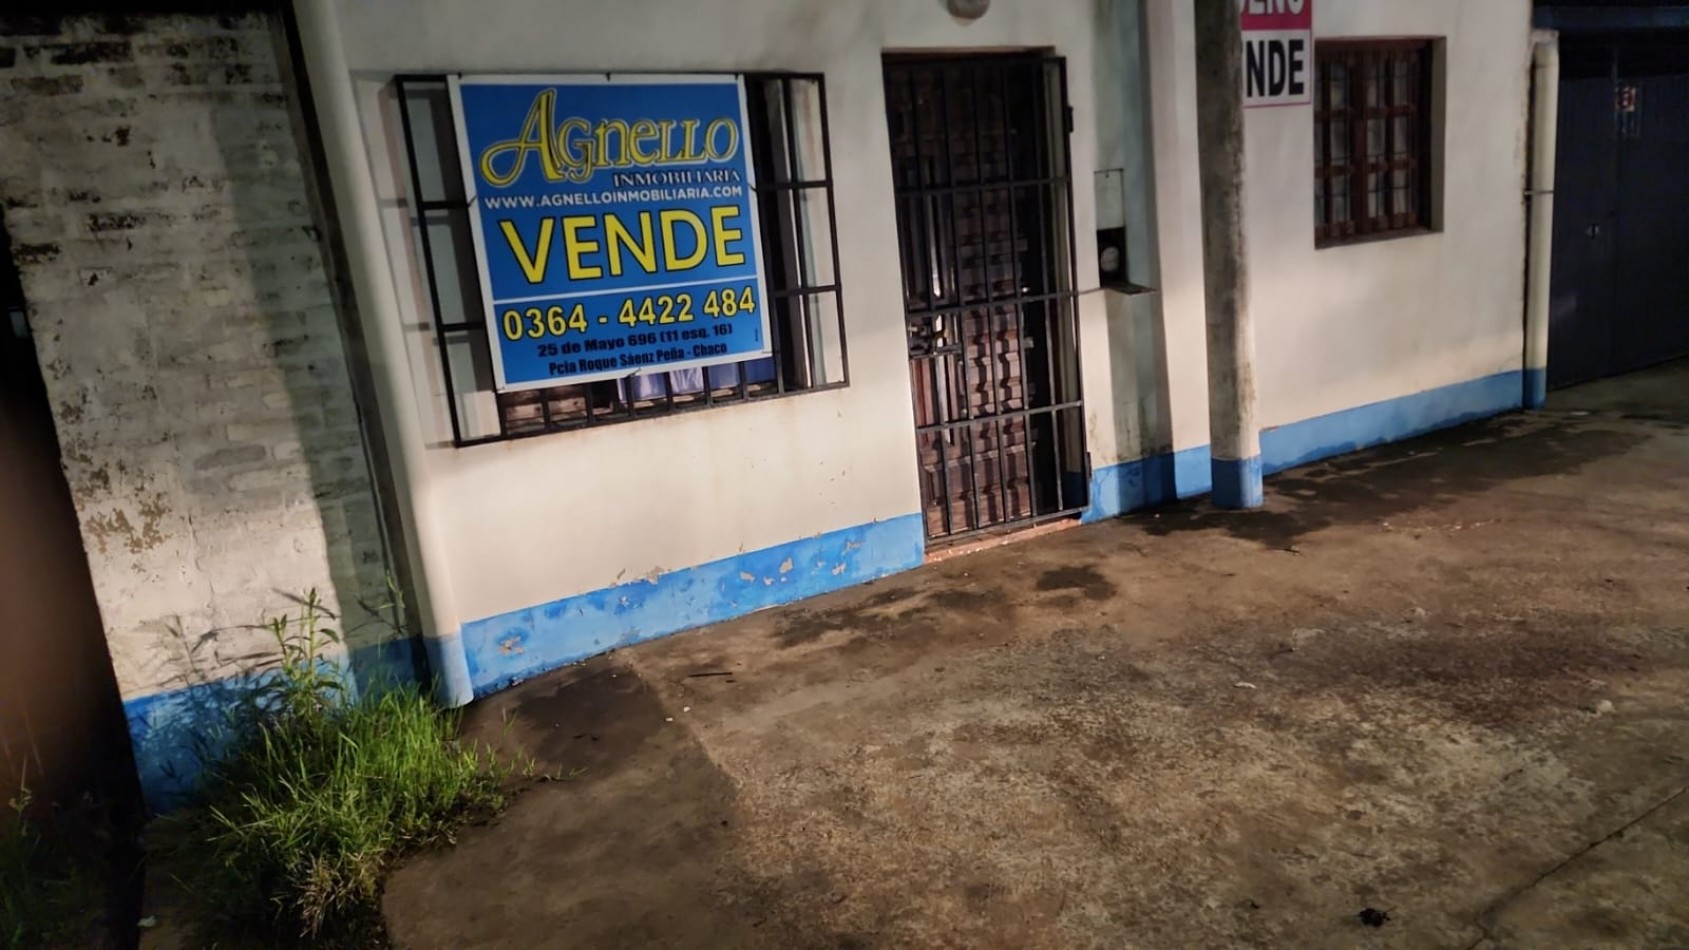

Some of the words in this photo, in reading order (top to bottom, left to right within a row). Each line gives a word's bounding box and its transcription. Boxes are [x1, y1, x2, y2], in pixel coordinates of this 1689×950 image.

[613, 168, 741, 188] INMOBILIARIA
[485, 185, 742, 210] WWW.AGNELLOINMOBILIARIA.COM
[499, 204, 746, 284] VENDE
[502, 303, 588, 341] 0364
[597, 314, 608, 325] -
[617, 292, 694, 328] 4422
[702, 285, 756, 318] 484
[538, 343, 558, 357] 25
[561, 341, 581, 354] de
[584, 338, 625, 352] Mayo
[628, 332, 657, 346] 696
[660, 329, 679, 343] (11
[681, 328, 710, 339] esq.
[713, 323, 733, 336] 16)
[549, 361, 577, 375] Pcia
[579, 357, 617, 372] Roque
[656, 346, 685, 361] Peña
[692, 343, 727, 357] Chaco
